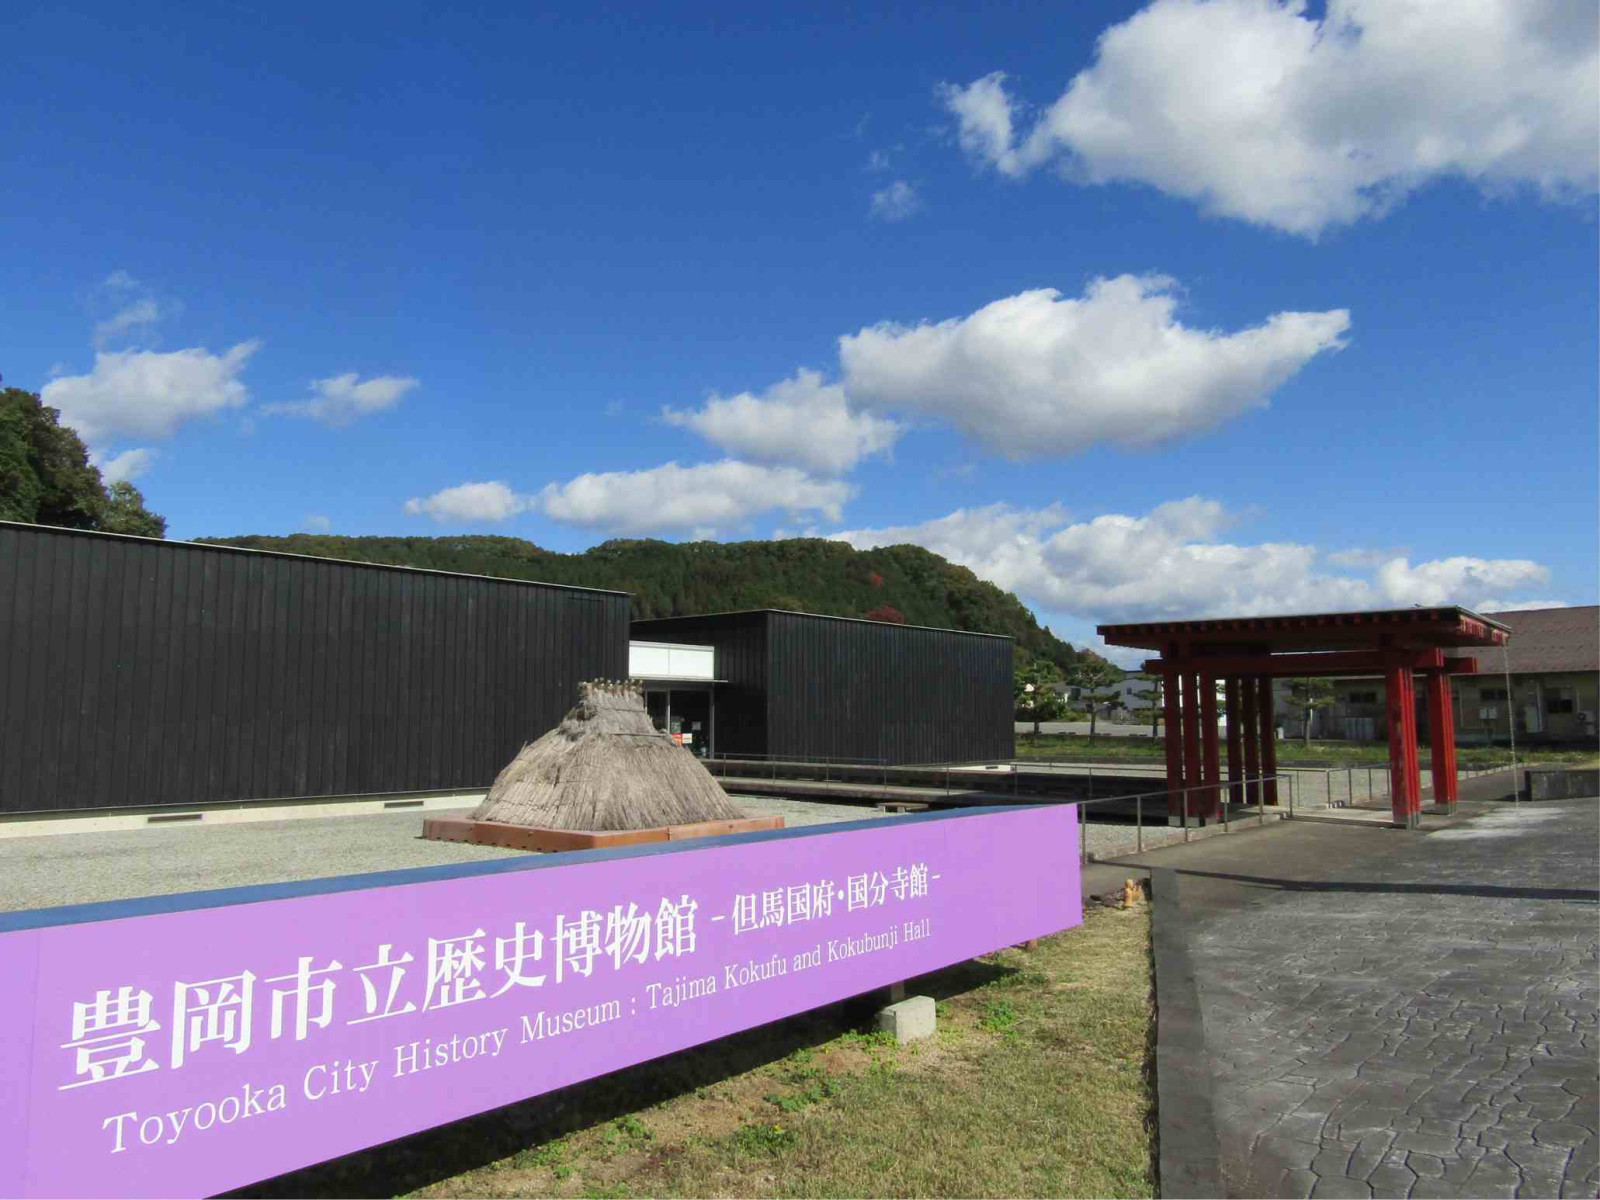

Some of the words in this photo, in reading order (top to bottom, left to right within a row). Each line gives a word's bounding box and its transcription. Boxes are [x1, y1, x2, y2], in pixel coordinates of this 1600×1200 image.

[58, 894, 699, 1091] 豊岡市立歴史博物館
[102, 1083, 287, 1154] Toyooka
[303, 1059, 380, 1100] City
[393, 1028, 509, 1078] History
[520, 1000, 621, 1044] Museum
[645, 975, 717, 1010] Tajima
[723, 954, 787, 990] Kokufu
[793, 943, 821, 972] and
[828, 928, 899, 963] Kokubunji
[903, 918, 932, 942] Hall
